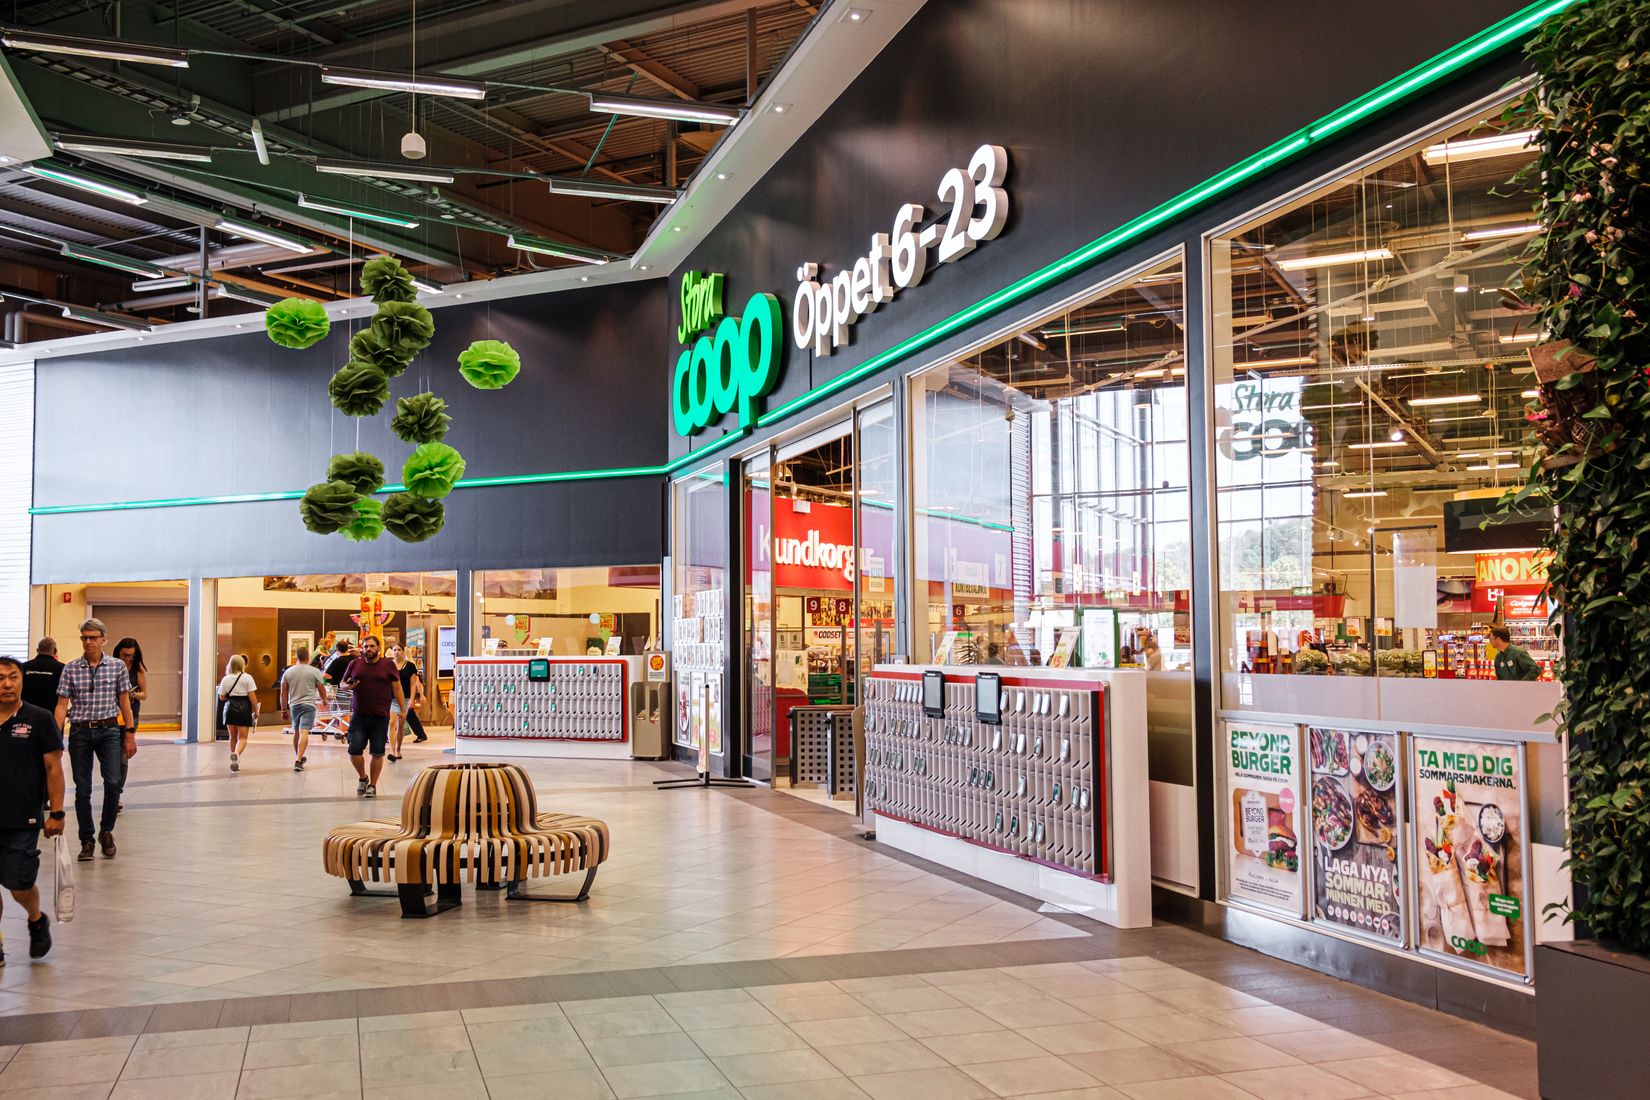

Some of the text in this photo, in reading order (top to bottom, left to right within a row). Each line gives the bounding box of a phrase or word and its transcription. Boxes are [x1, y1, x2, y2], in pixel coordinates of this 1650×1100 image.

[677, 270, 724, 344] Stora
[793, 232, 893, 357] Öppet
[810, 600, 818, 611] 9
[839, 601, 846, 612] 8
[955, 606, 962, 615] 6
[1231, 730, 1291, 753] BEYOND
[1231, 750, 1292, 775] BURGER
[1418, 749, 1513, 776] TA MED DIG
[1419, 768, 1517, 789] SOMMARSMAKERNA.
[1245, 814, 1265, 823] BURGER
[1324, 855, 1390, 884] LAGA NYA
[1325, 871, 1390, 901] SOMMAR-
[1325, 887, 1391, 915] MINNEN MED
